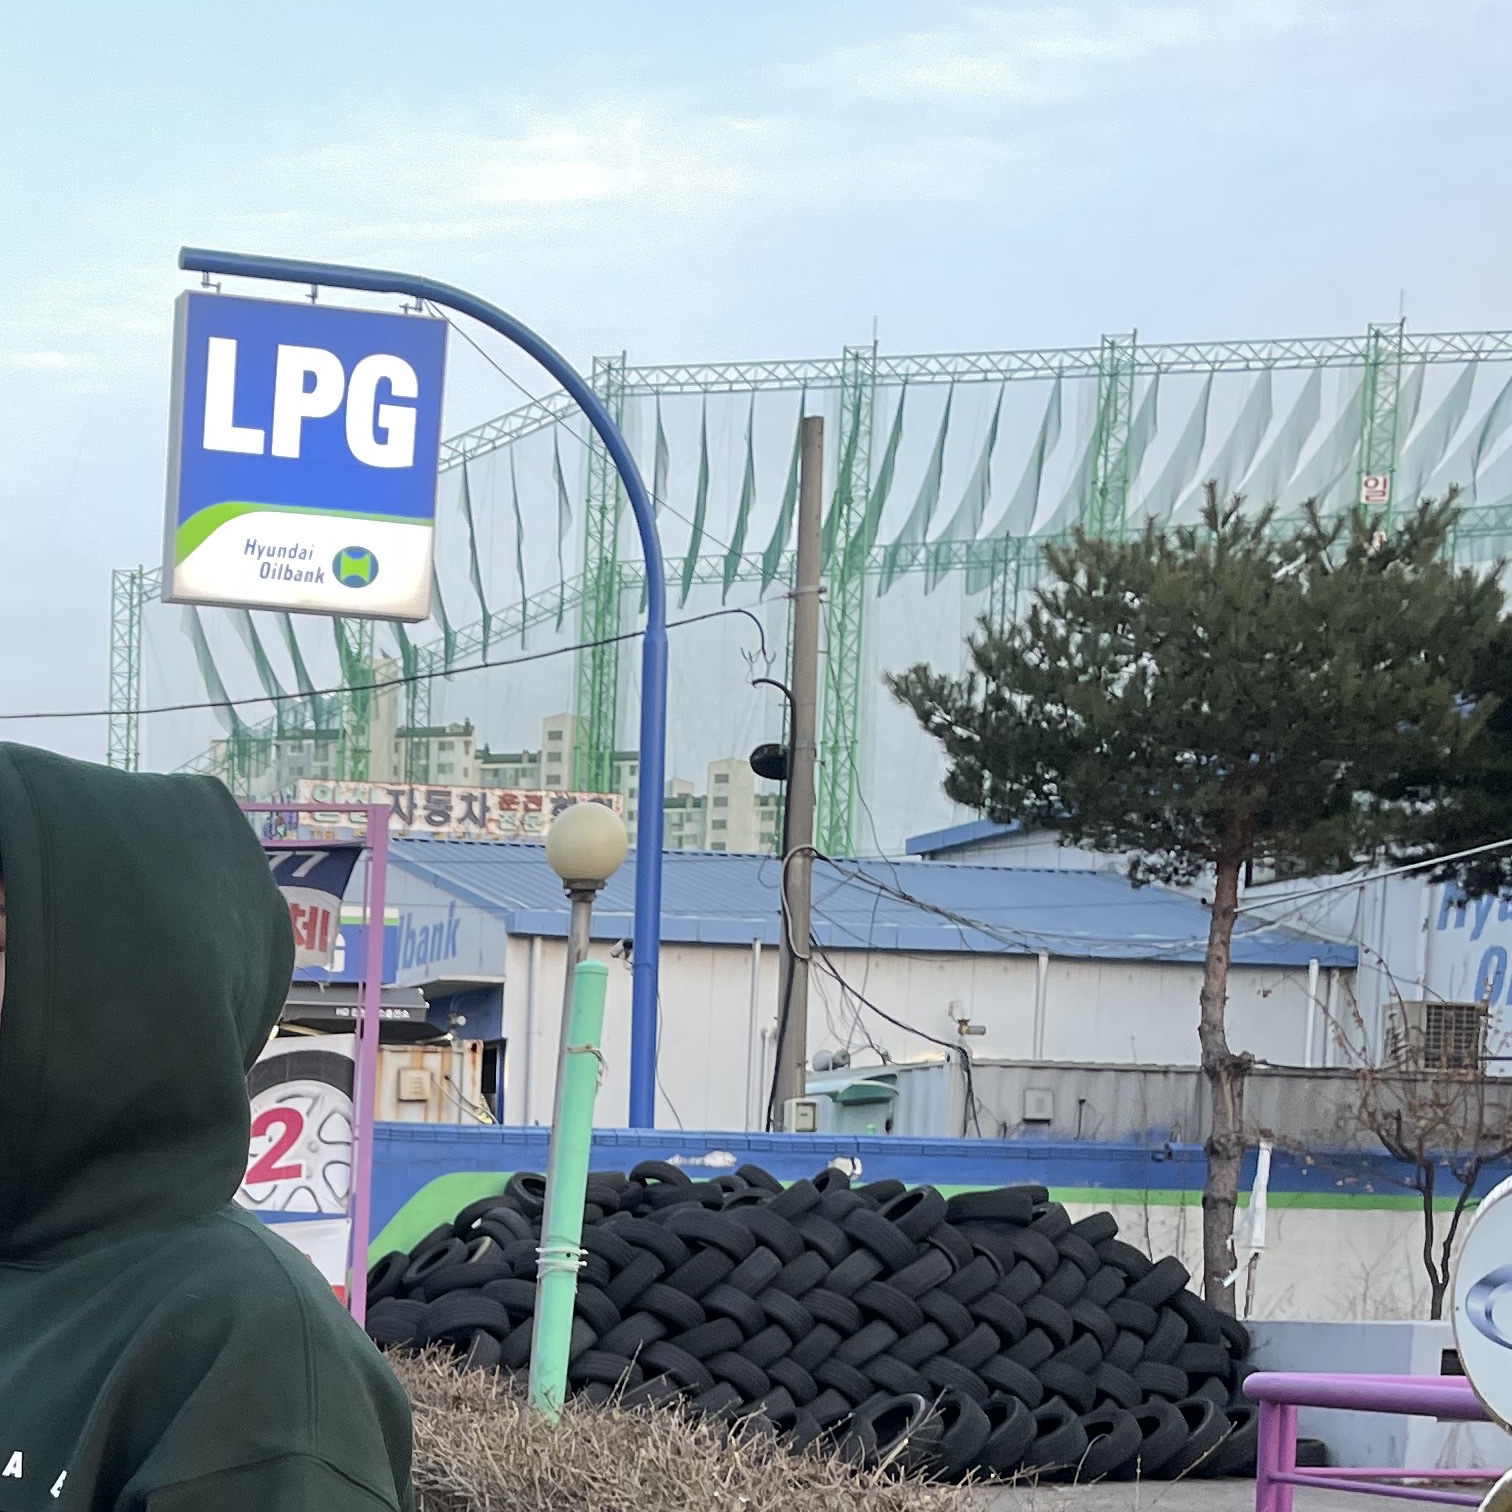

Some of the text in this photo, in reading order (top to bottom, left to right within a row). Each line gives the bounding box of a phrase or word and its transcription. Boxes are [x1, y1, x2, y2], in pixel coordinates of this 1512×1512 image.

[202, 336, 419, 469] LPG
[244, 538, 315, 563] Hyundai
[259, 561, 325, 585] Oilbank
[388, 789, 490, 829] 자동차
